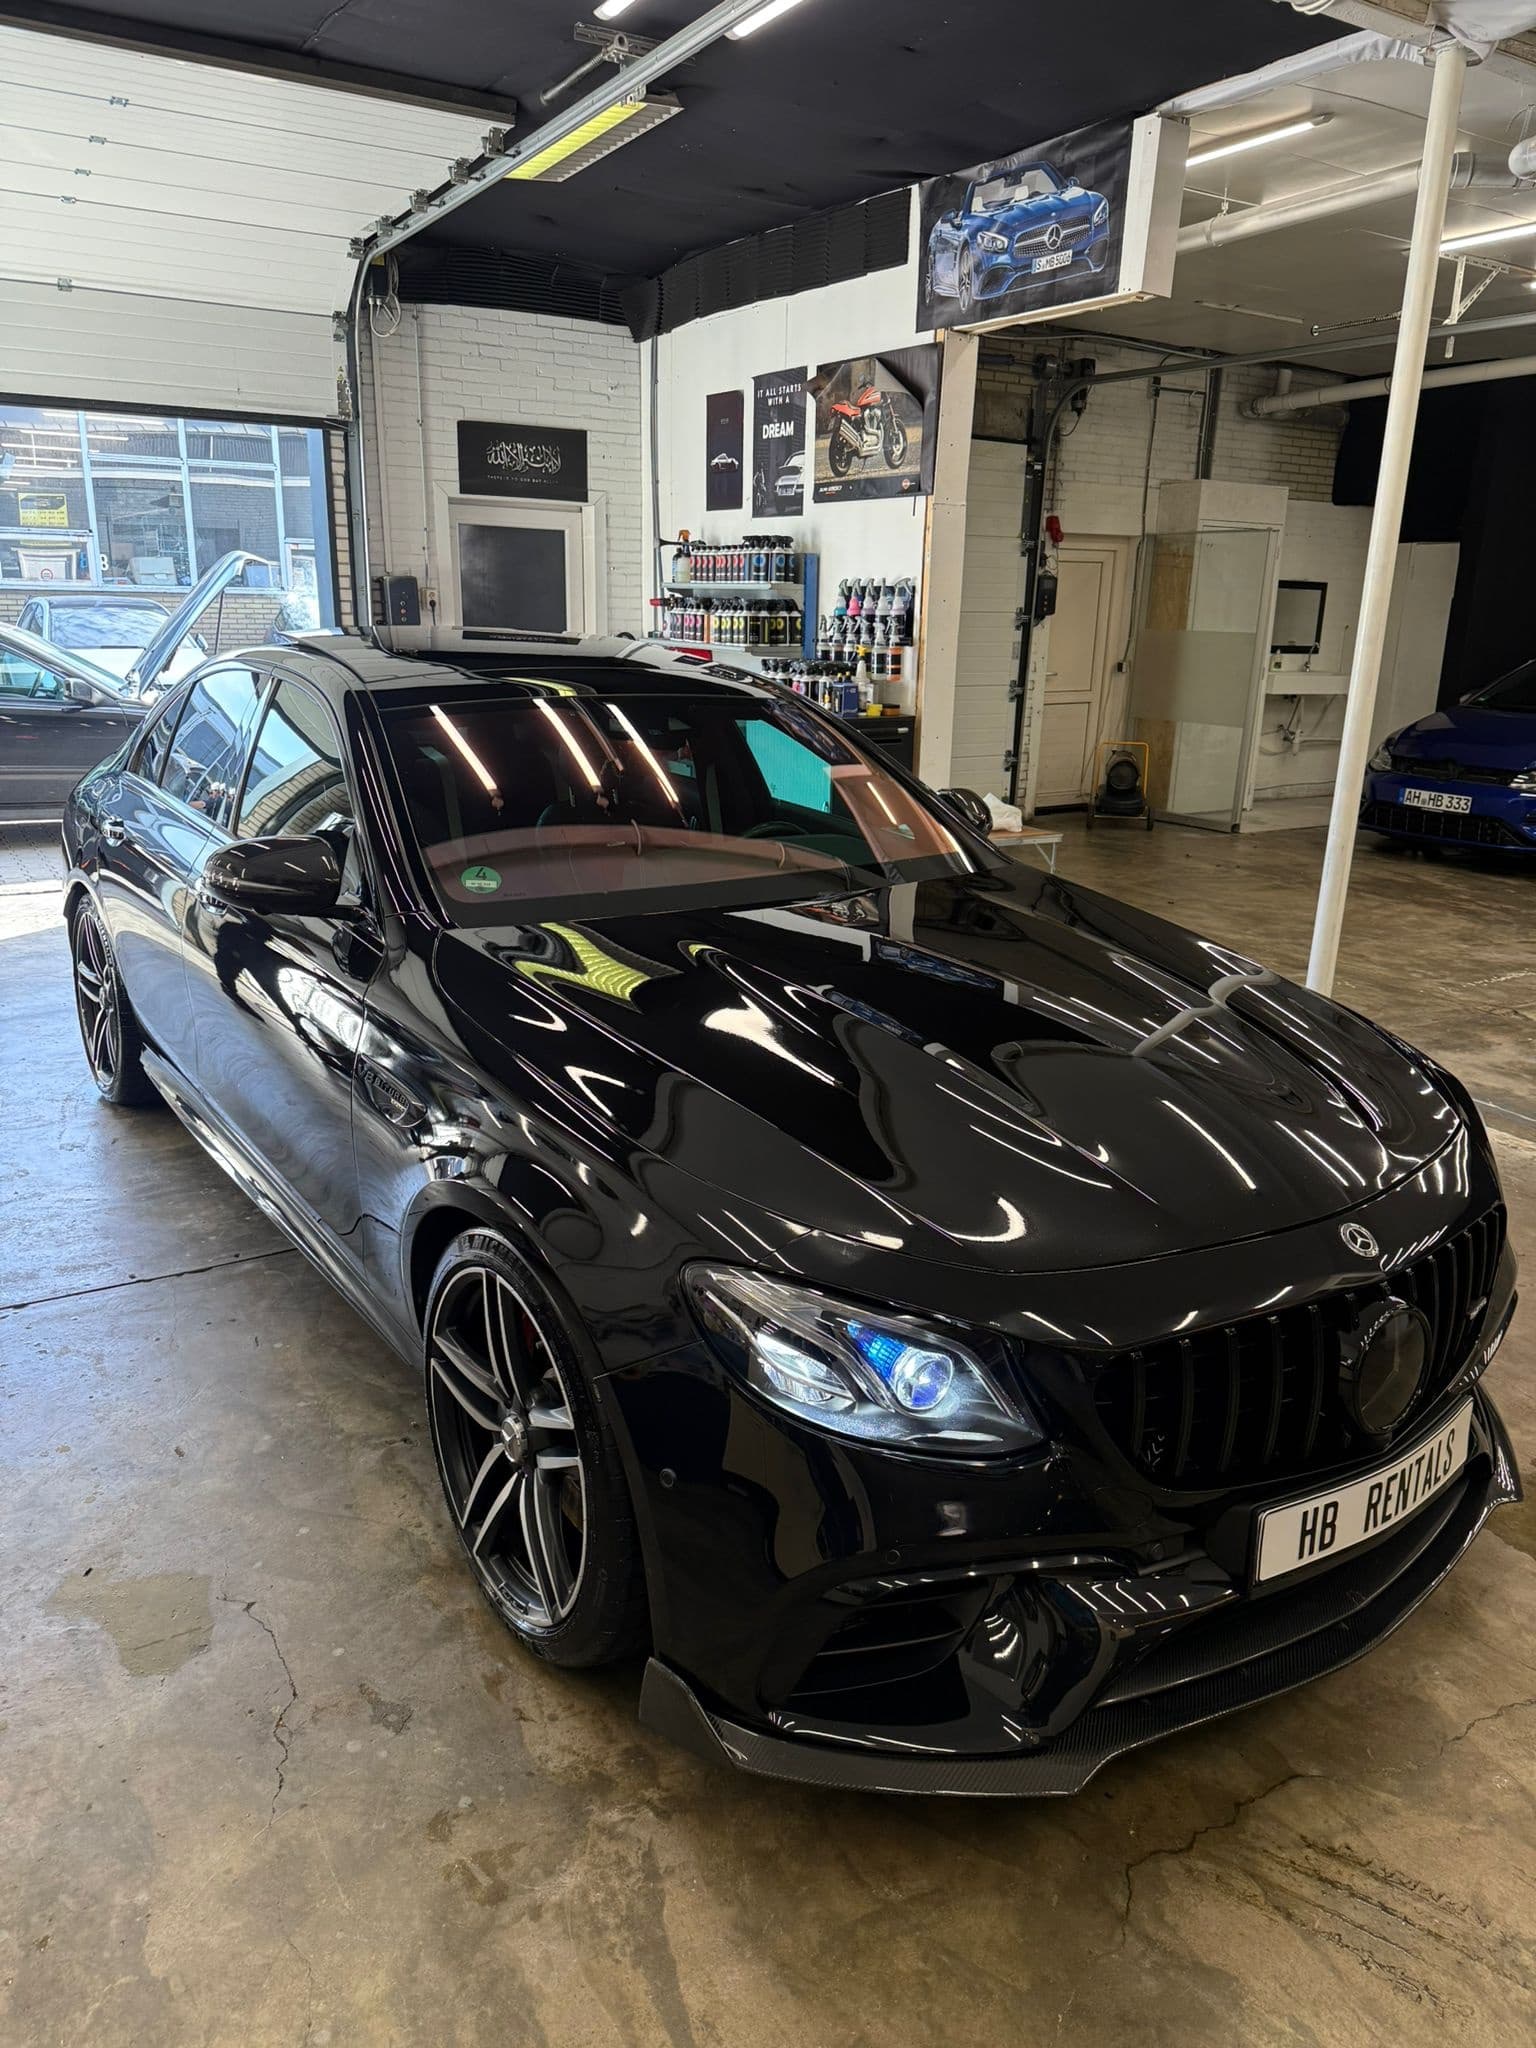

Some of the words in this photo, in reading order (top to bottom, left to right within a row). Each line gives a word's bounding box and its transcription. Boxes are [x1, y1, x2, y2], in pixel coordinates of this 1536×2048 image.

[757, 388, 764, 399] IT
[766, 387, 777, 397] ALL
[778, 382, 802, 395] STARTS
[767, 396, 783, 407] WITH
[785, 394, 790, 404] A
[762, 420, 795, 440] DREAM
[1405, 790, 1422, 805] AH
[1428, 794, 1444, 808] HB
[1445, 796, 1470, 811] 333
[1298, 1500, 1339, 1561] HB
[1363, 1427, 1455, 1533] RENTALS
